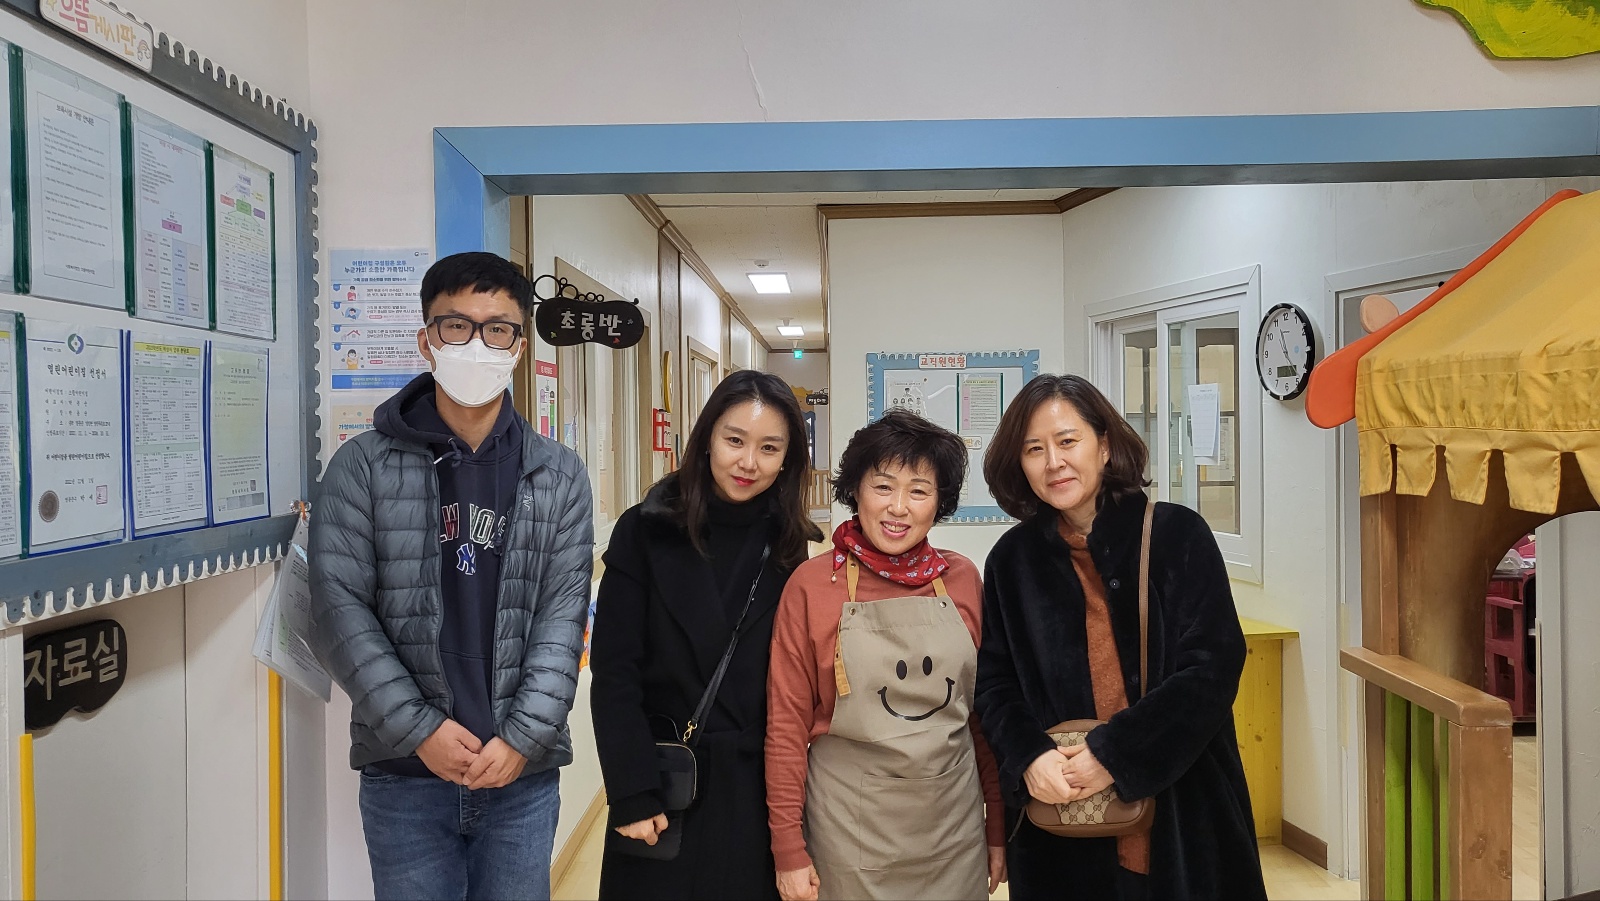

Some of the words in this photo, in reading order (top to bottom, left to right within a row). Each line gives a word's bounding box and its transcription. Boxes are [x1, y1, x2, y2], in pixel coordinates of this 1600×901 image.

[1283, 313, 1289, 321] 12
[1294, 316, 1298, 324] 1
[560, 310, 623, 340] 초롱반
[1273, 319, 1279, 327] 11
[1267, 333, 1274, 341] 10
[920, 356, 965, 367] 교직원현황
[47, 363, 86, 378] 열린어린이집
[24, 626, 119, 700] 자료실
